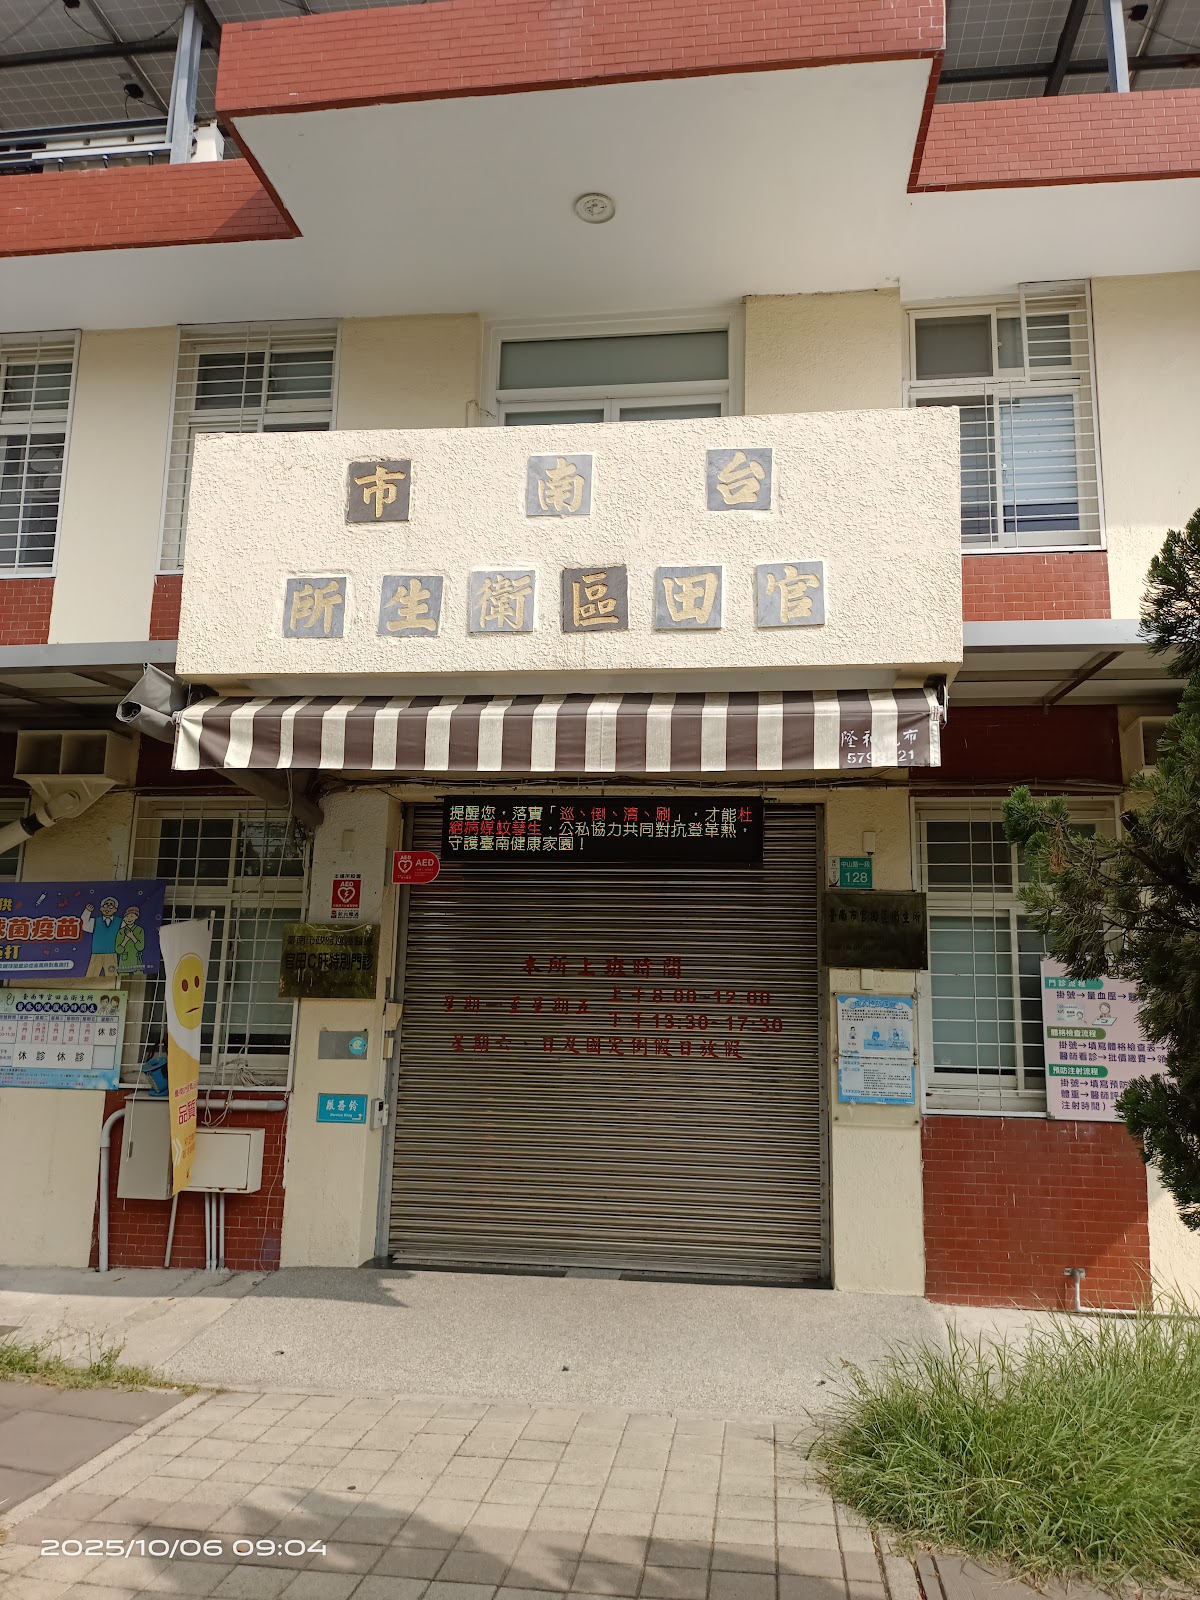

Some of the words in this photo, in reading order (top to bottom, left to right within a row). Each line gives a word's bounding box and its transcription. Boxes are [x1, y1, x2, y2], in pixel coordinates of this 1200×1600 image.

[415, 858, 435, 867] AED
[841, 860, 871, 868] 中山路一段
[845, 872, 868, 883] 128
[285, 952, 374, 971] 官田C肝特別門診
[523, 955, 682, 980] 本所上班時間
[1056, 990, 1076, 1000] 掛號
[1087, 991, 1117, 1001] 量血壓
[444, 995, 592, 1014] 星期一至星期五
[98, 1028, 117, 1036] 休診
[1058, 1040, 1078, 1050] 掛號
[1053, 1066, 1099, 1076] 預防注射流程
[1060, 1078, 1080, 1088] 掛號
[1060, 1089, 1080, 1100] 體重
[326, 1099, 358, 1112] 服務鈴
